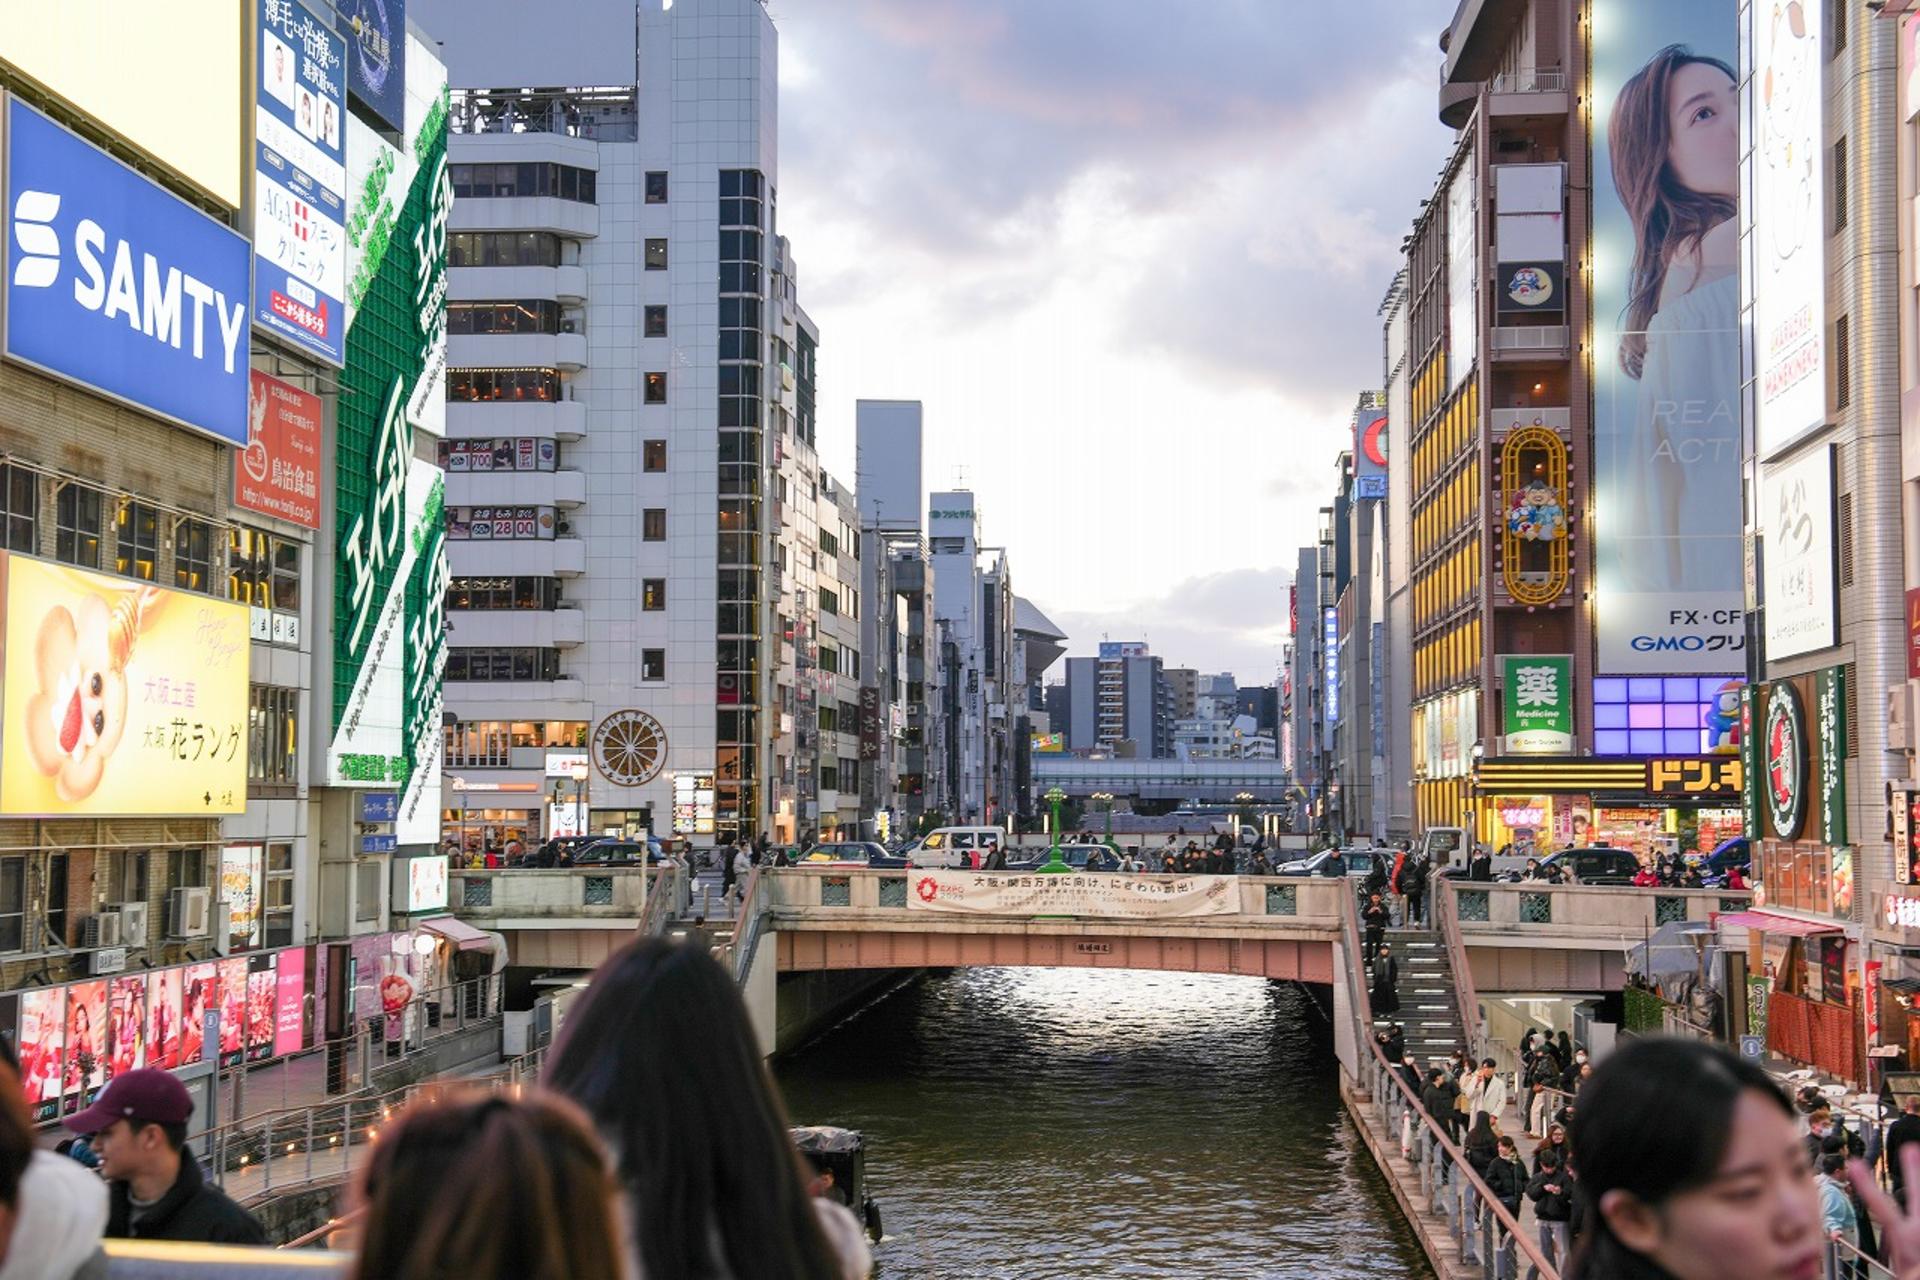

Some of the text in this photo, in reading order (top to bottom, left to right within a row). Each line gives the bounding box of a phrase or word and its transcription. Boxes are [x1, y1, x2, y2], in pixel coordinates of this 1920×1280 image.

[74, 218, 246, 374] SAMTY
[345, 374, 416, 657] エイブル
[1516, 666, 1559, 706] 薬
[1516, 709, 1559, 719] Medicine
[939, 885, 965, 895] EXPO
